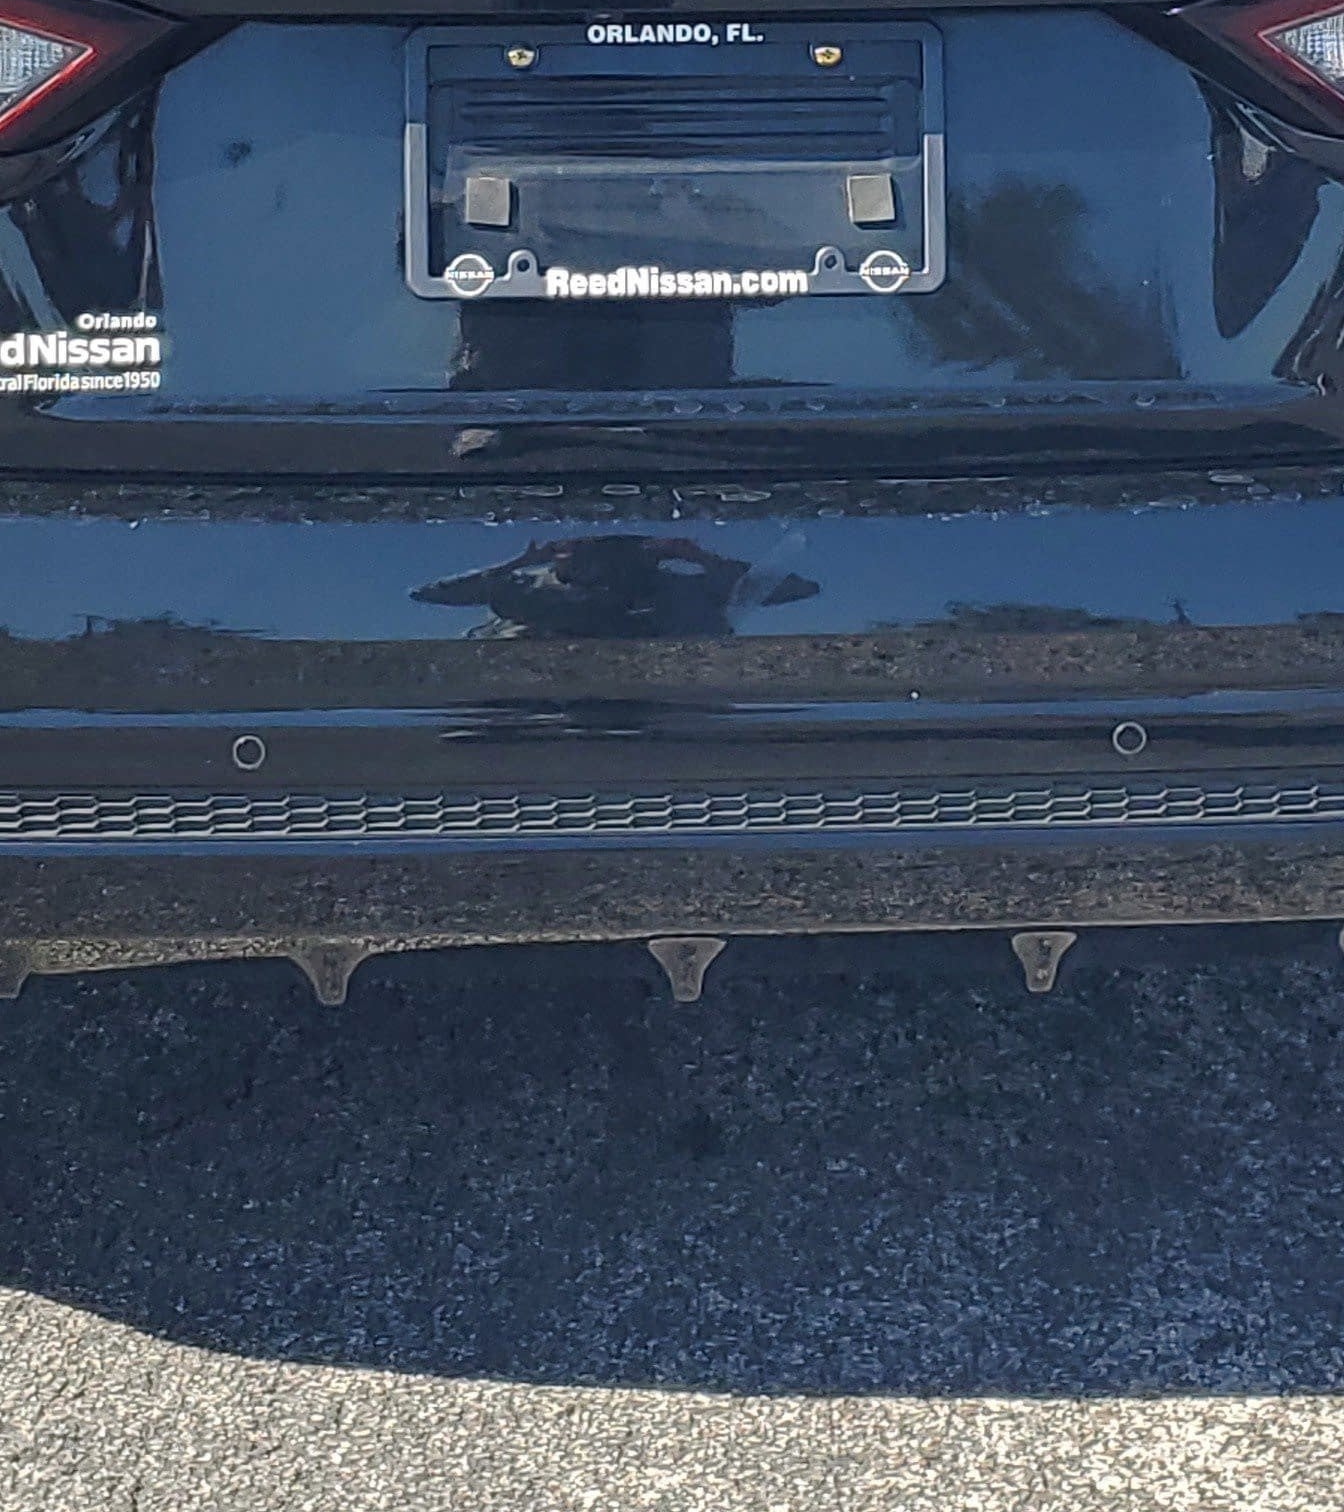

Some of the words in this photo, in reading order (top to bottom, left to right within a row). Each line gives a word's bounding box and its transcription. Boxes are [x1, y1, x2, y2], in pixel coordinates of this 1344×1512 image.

[587, 24, 720, 46] ORLANDO,
[726, 23, 764, 42] FL.
[546, 266, 809, 297] ReedNissan.com
[860, 266, 910, 276] NISSAN
[76, 312, 158, 331] Orlando
